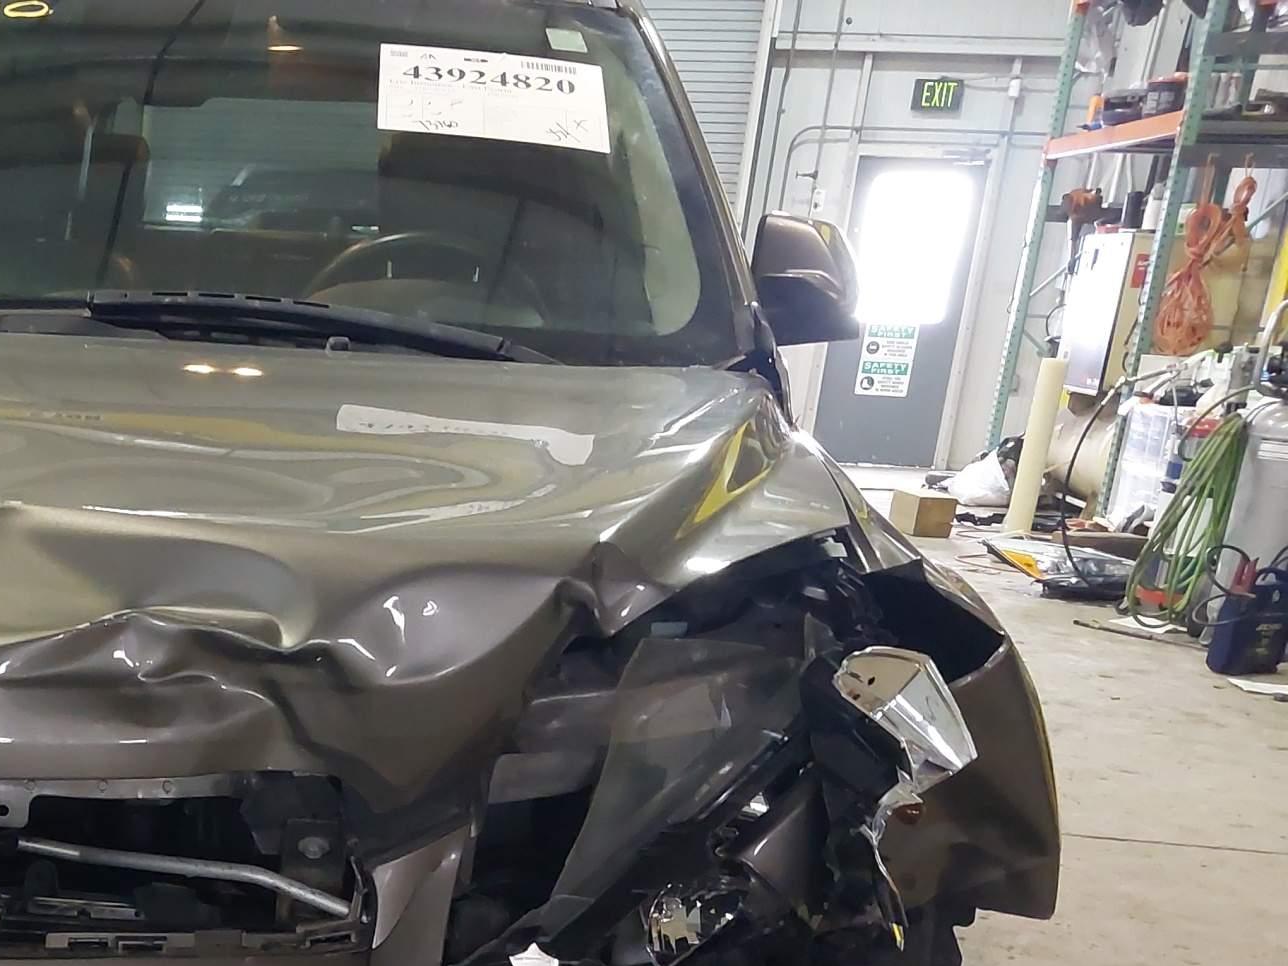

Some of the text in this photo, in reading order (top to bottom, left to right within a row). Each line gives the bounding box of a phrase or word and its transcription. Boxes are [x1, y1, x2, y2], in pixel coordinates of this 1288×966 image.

[402, 64, 576, 95] 43924820
[921, 81, 958, 108] EXIT
[864, 361, 907, 371] SAFETY
